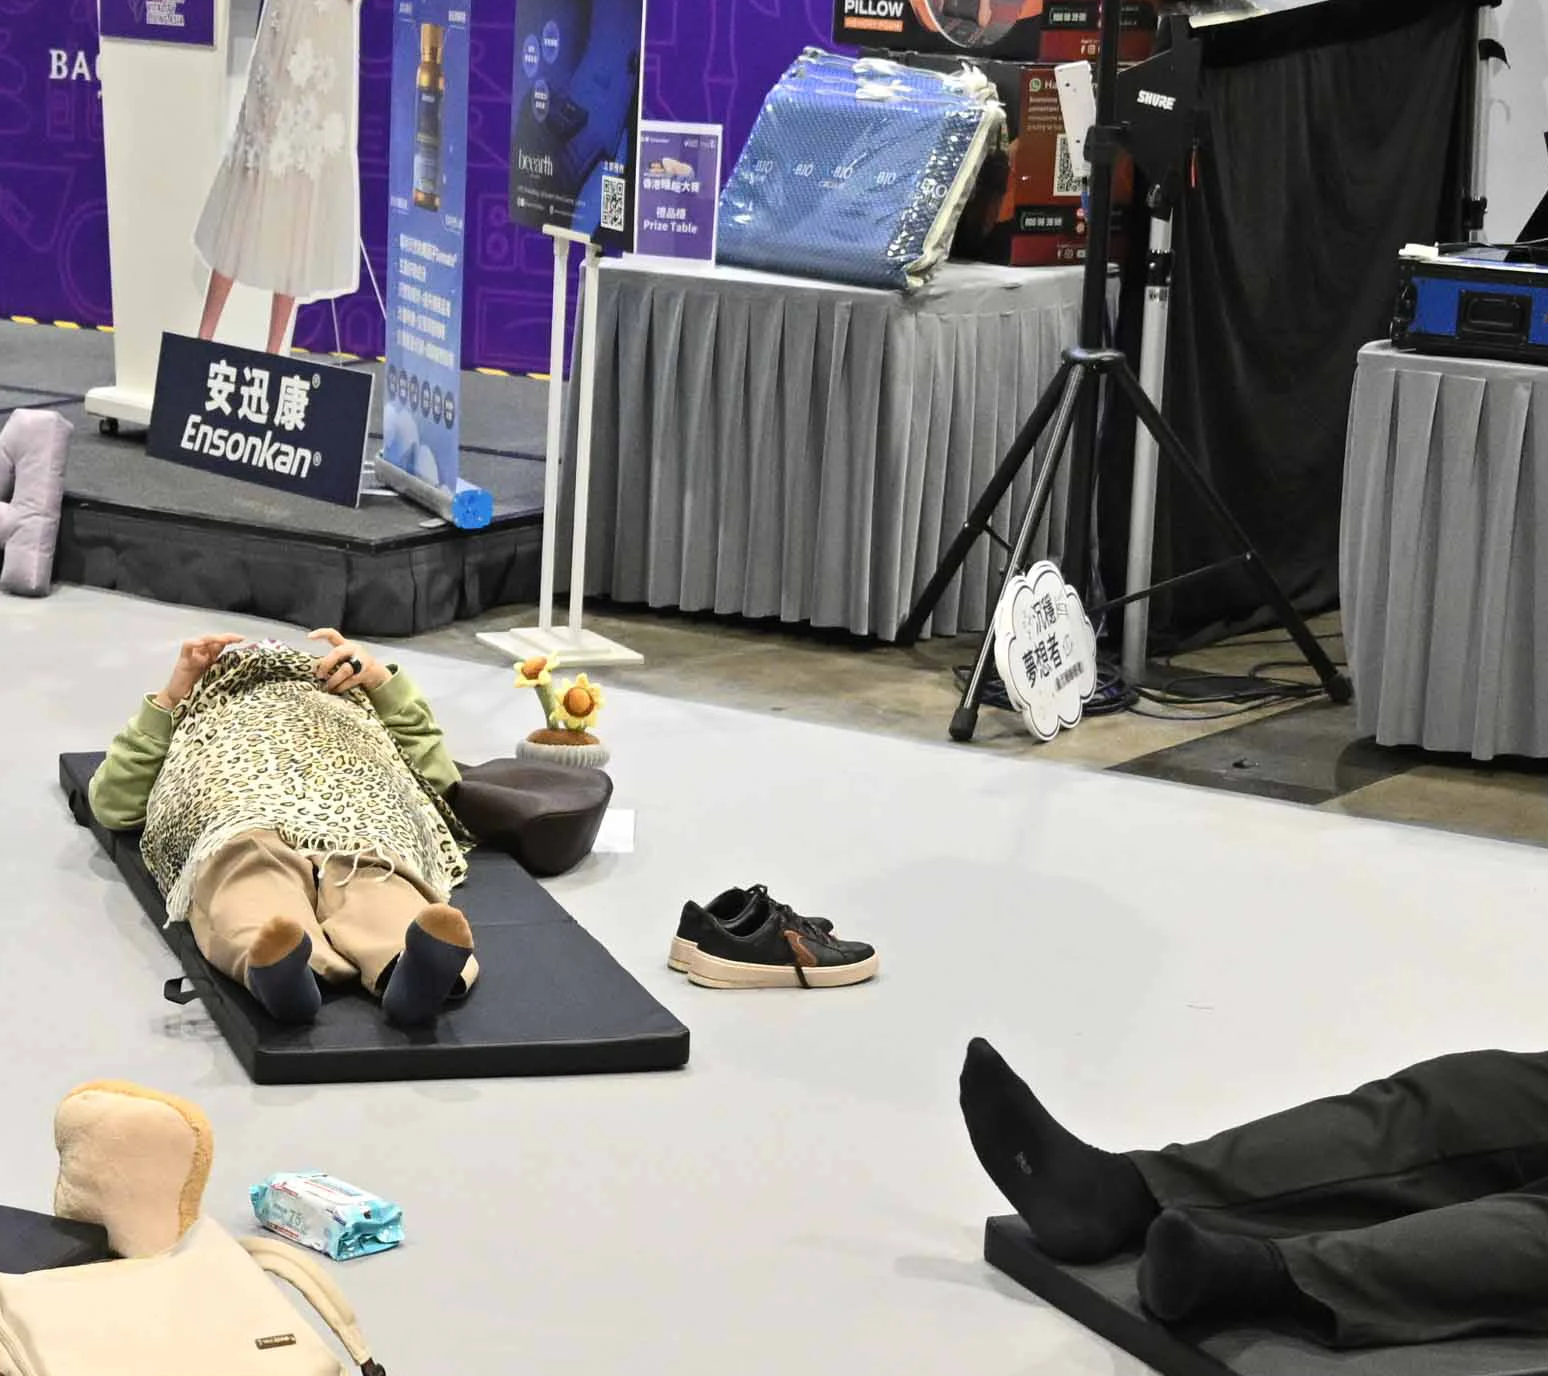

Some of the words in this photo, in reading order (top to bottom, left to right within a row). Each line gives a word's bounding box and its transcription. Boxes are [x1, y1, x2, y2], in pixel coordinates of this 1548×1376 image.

[1136, 89, 1177, 111] SHURE
[642, 219, 670, 232] Prize
[670, 221, 699, 235] Table
